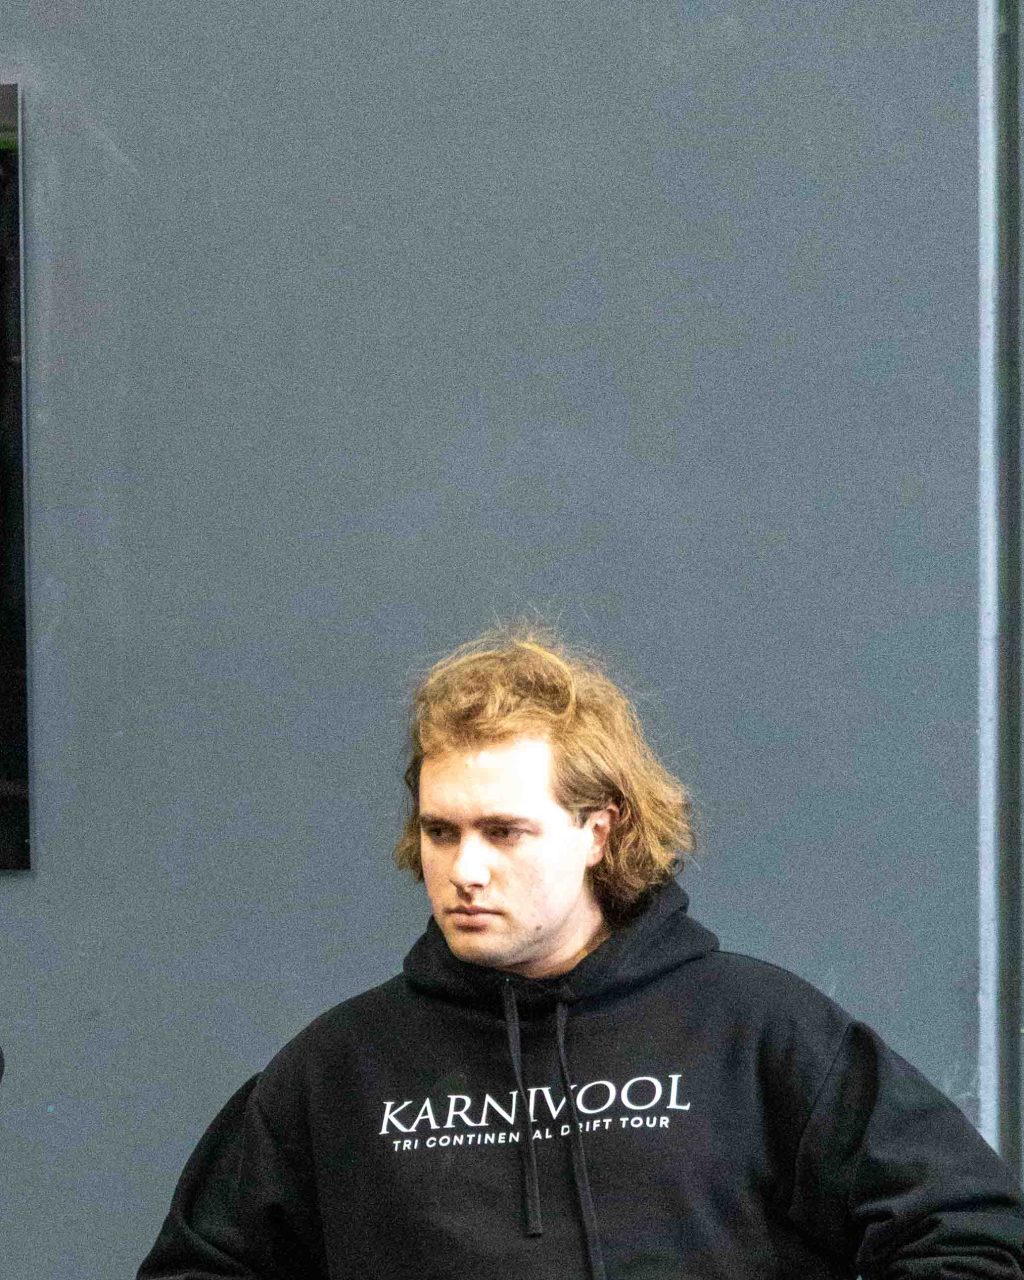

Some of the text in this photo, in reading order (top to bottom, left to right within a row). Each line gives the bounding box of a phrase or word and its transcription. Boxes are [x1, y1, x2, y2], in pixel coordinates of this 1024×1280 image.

[379, 1074, 691, 1135] KARNIVOOL
[393, 1139, 419, 1152] TRI
[426, 1129, 552, 1149] CONTINENAL
[620, 1116, 670, 1130] TOUR
